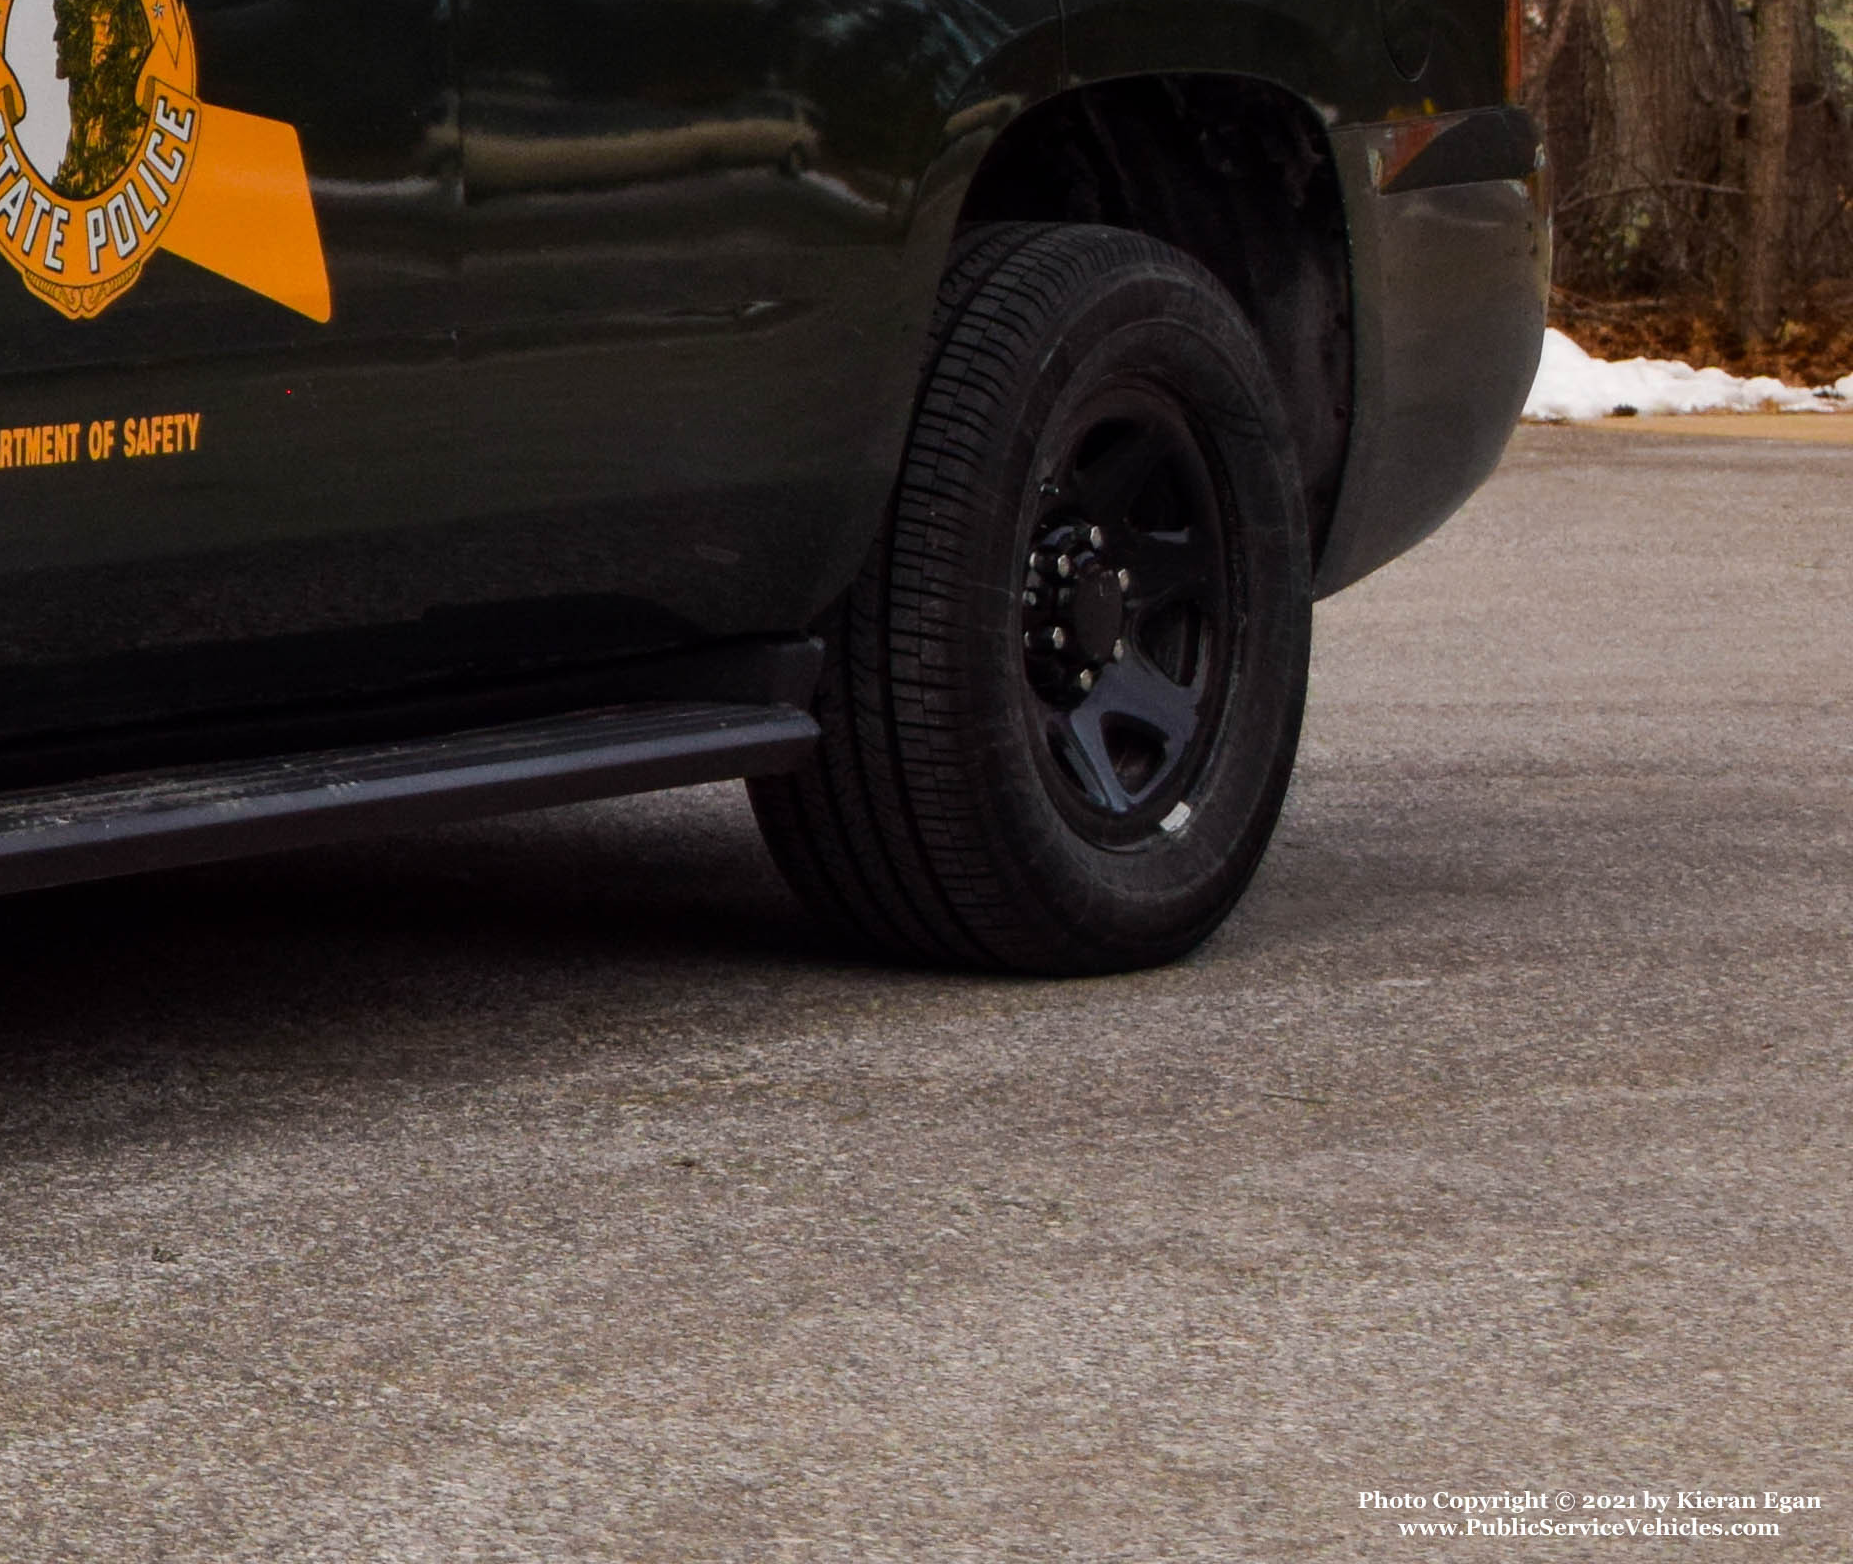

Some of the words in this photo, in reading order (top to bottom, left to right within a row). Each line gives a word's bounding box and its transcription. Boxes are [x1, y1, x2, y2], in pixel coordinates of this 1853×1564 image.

[85, 98, 193, 273] POLICE
[88, 419, 116, 461] OF
[123, 412, 201, 458] SAFETY
